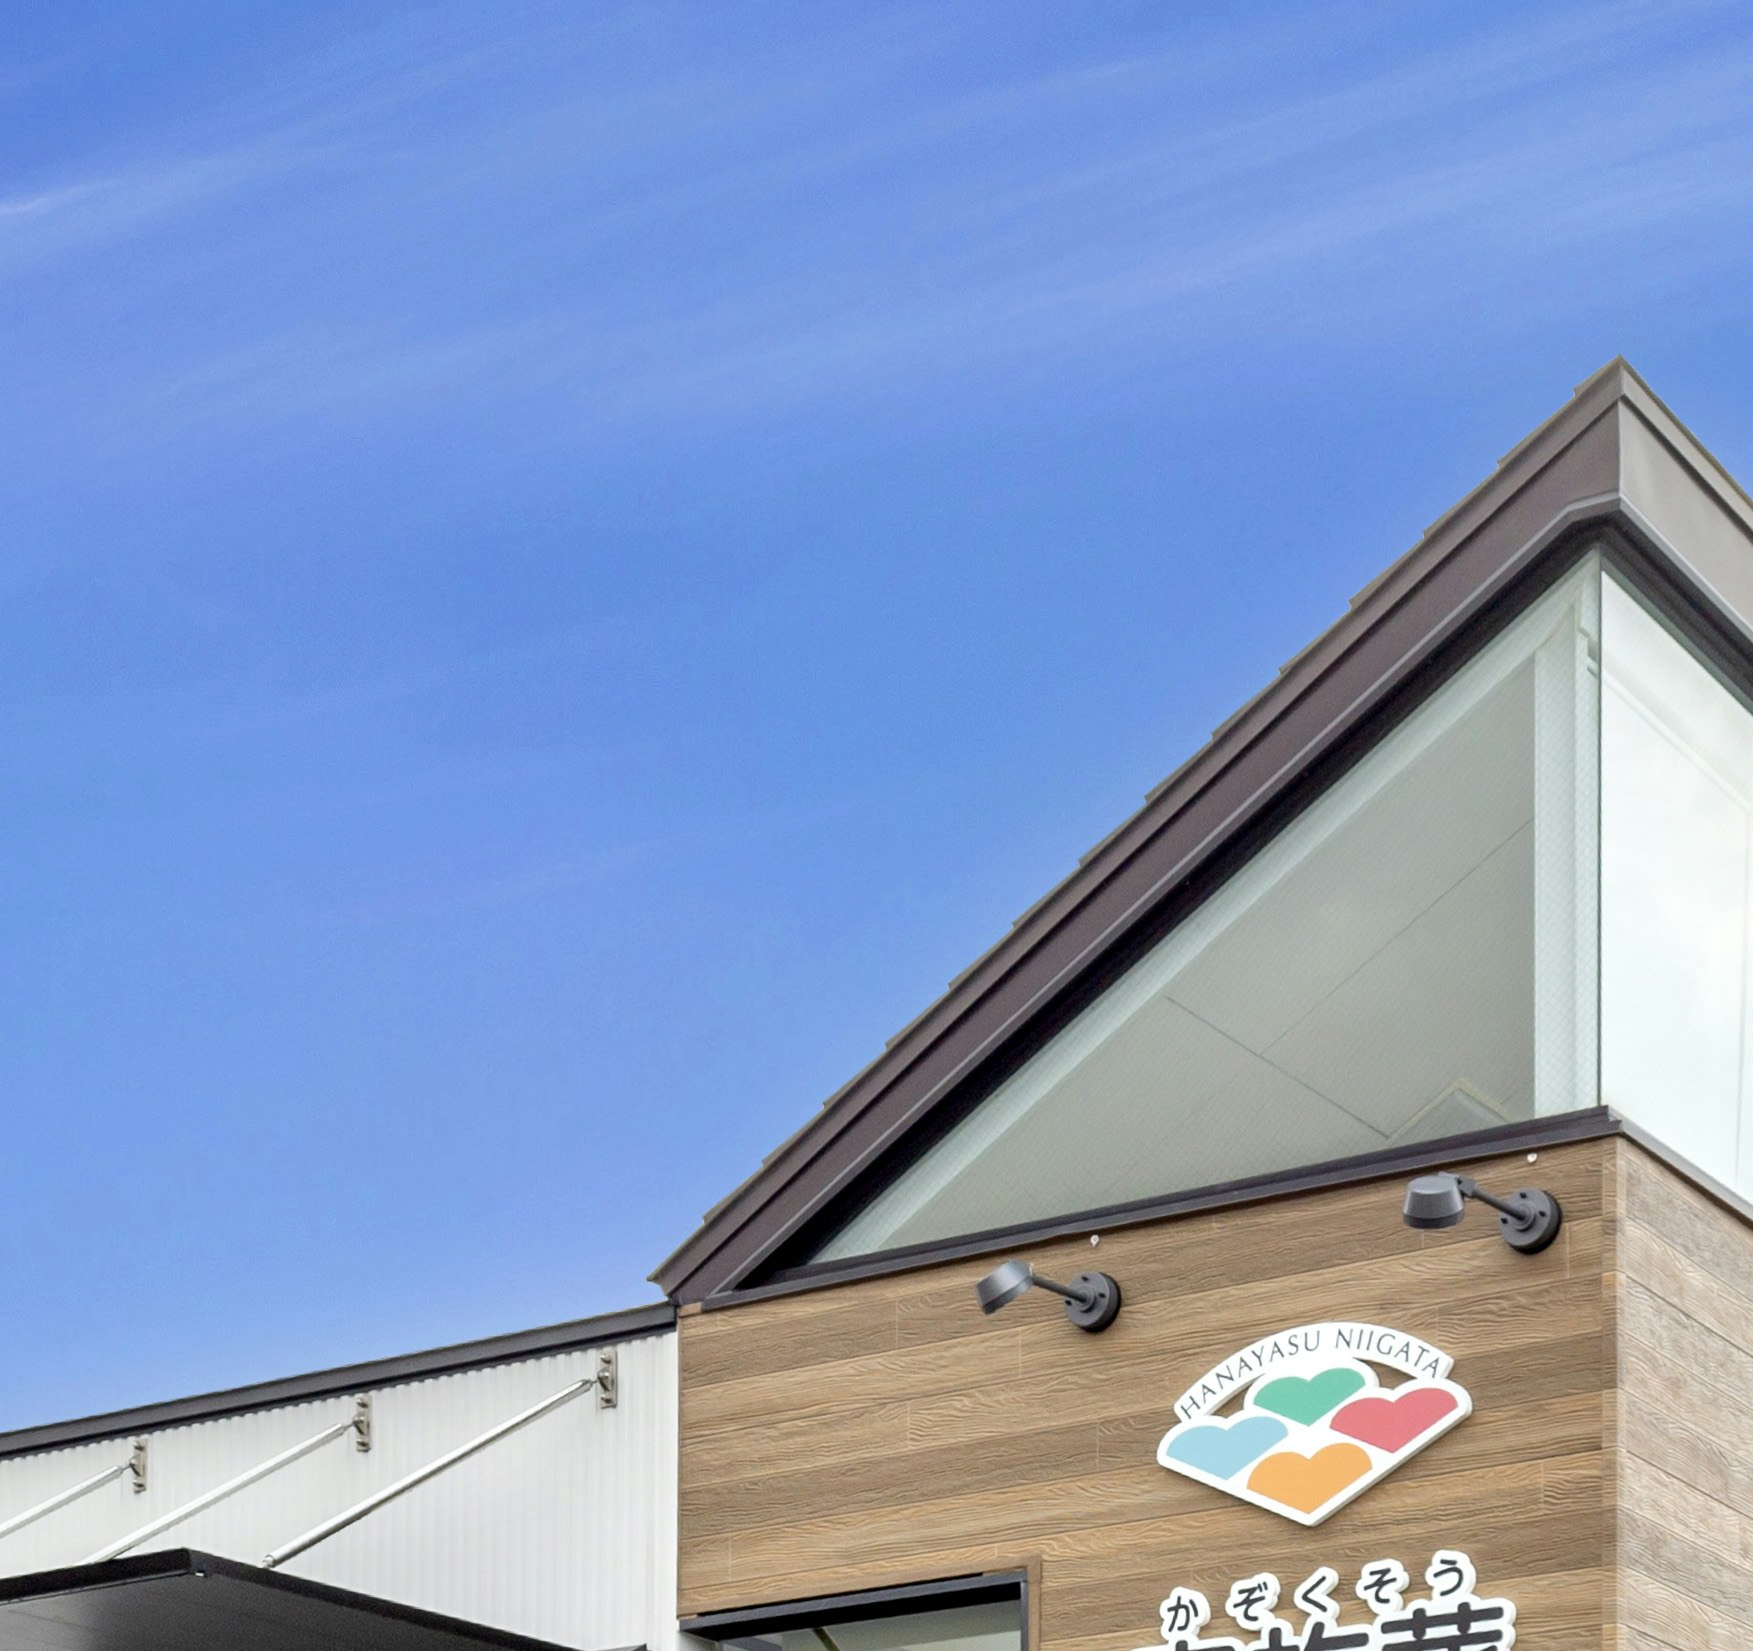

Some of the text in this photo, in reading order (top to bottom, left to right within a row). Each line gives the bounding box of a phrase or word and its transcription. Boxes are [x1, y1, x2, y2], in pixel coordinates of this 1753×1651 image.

[1179, 1327, 1441, 1421] HANAYASU NIIGATA
[1166, 1558, 1465, 1633] かぞくそう
